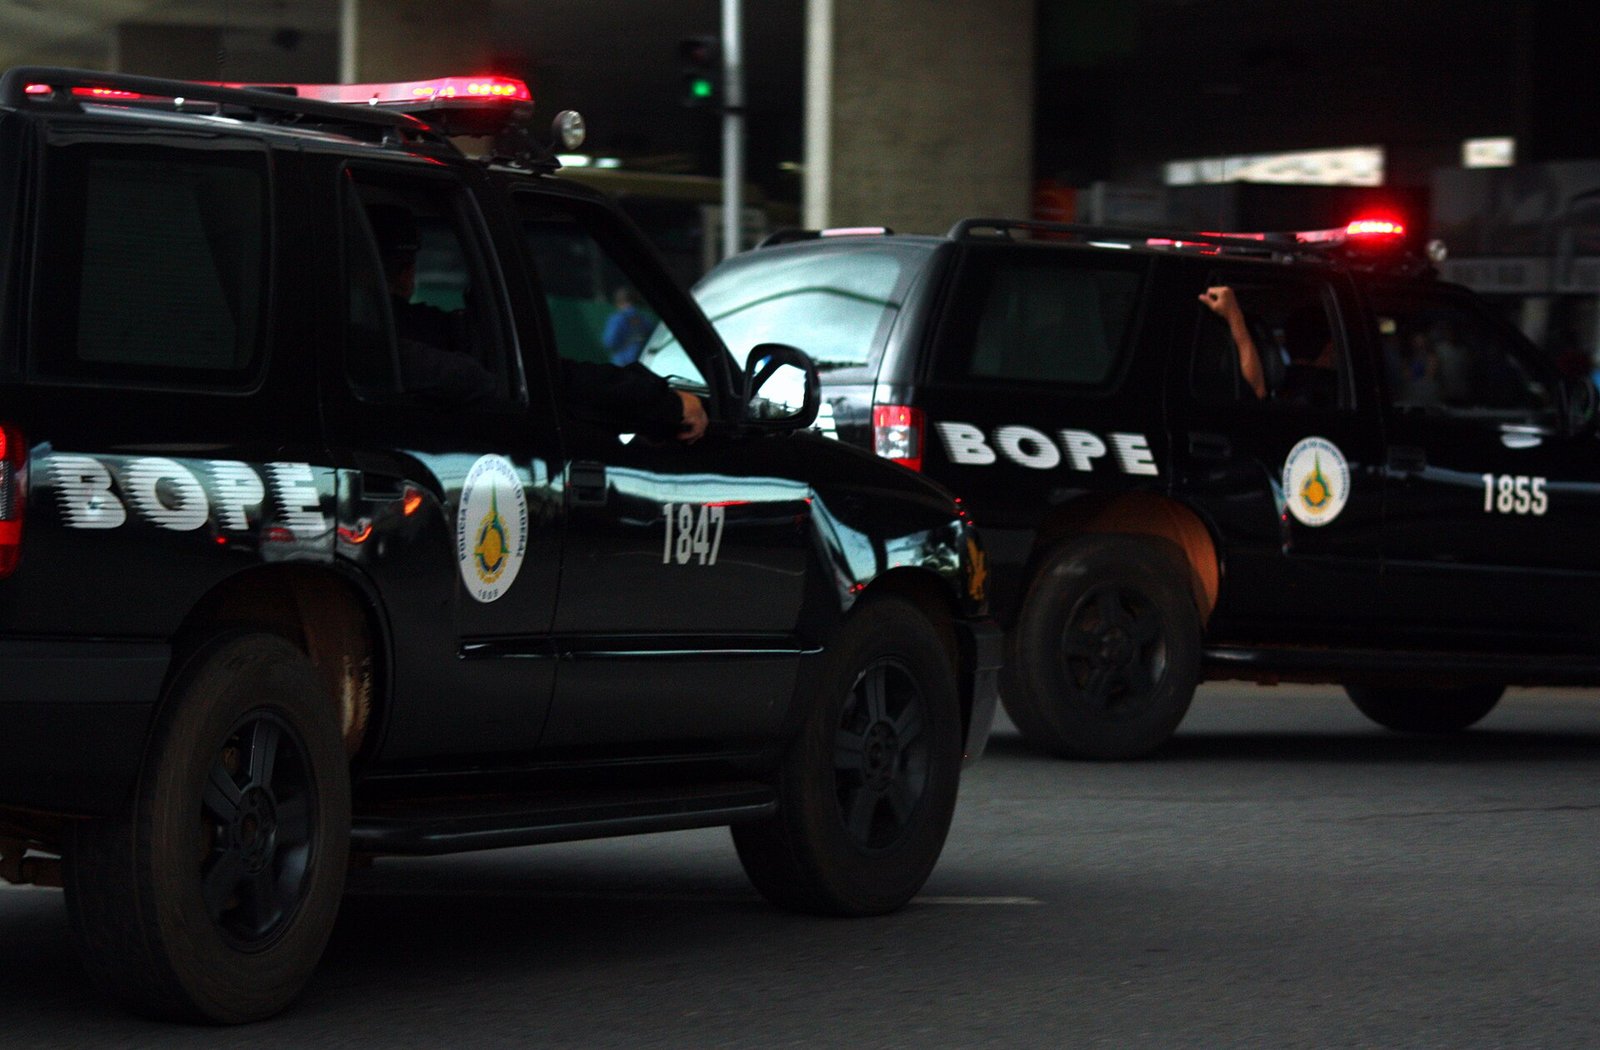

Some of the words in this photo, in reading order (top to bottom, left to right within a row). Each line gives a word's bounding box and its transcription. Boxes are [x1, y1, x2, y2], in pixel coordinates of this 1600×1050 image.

[936, 421, 1159, 476] BOPE
[43, 455, 327, 531] BOPE
[1482, 473, 1549, 516] 1855
[662, 503, 725, 566] 1847
